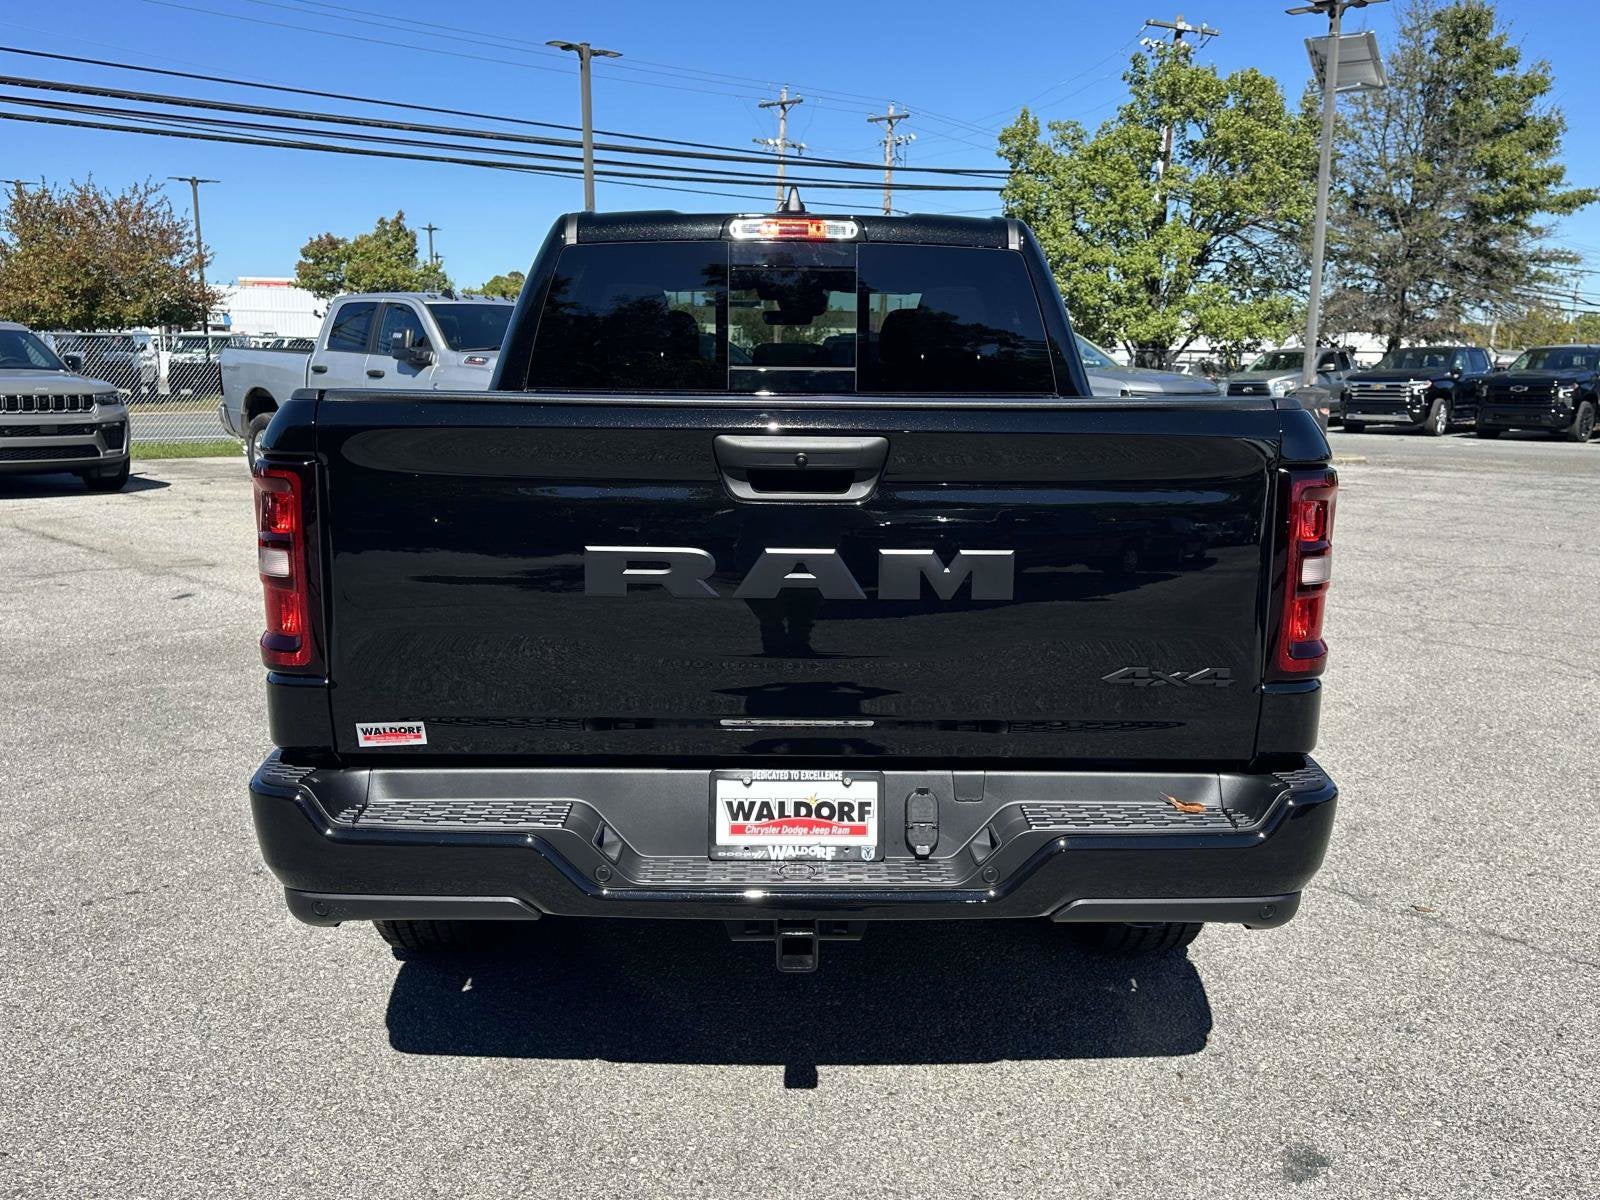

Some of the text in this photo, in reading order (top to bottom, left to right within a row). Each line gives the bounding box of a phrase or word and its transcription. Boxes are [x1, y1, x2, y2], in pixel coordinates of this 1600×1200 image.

[584, 545, 1015, 600] RAM
[361, 727, 422, 735] WALDORF
[752, 770, 843, 781] DEDICATED TO EXCELLENCE
[725, 800, 872, 822] WALDORF
[745, 825, 850, 836] Chrysler Dodge Jeep Ram
[768, 845, 836, 860] WALDORF
